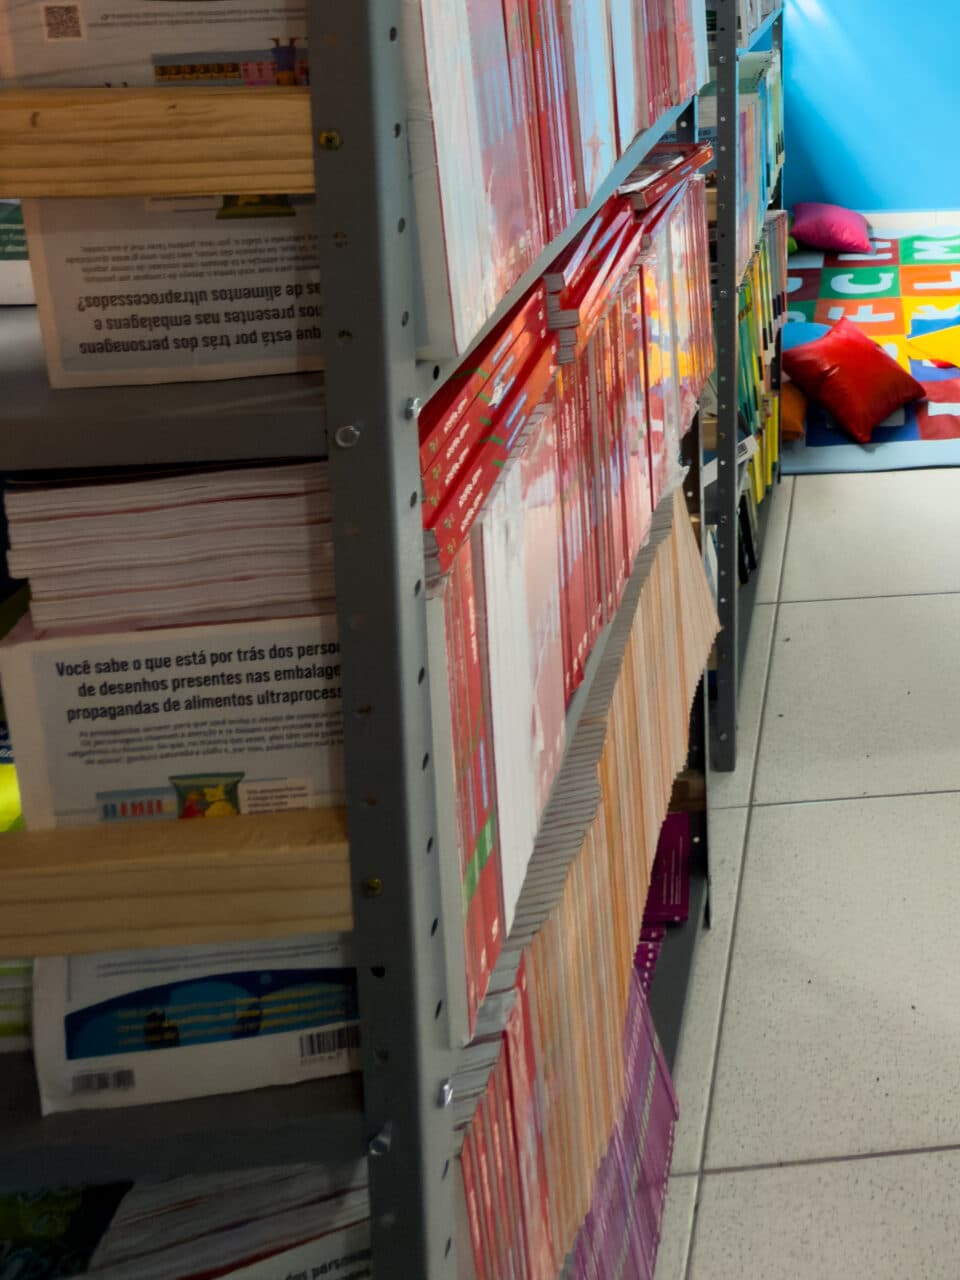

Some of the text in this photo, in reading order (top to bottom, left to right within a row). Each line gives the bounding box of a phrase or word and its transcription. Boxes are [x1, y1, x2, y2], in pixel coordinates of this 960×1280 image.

[211, 284, 282, 303] alimentos
[285, 282, 304, 299] de
[77, 289, 208, 313] ultraprocessados?
[105, 312, 192, 332] embalagens
[195, 312, 220, 327] nas
[223, 303, 295, 324] presentes
[94, 317, 103, 331] e
[79, 335, 170, 357] personagens
[173, 335, 198, 351] dos
[202, 333, 231, 351] trás
[236, 330, 257, 345] por
[262, 329, 292, 347] está
[56, 658, 91, 677] Você
[95, 657, 129, 674] sabe
[133, 658, 141, 671] o
[145, 656, 172, 674] que
[176, 650, 207, 667] está
[210, 651, 233, 670] por
[237, 646, 266, 662] trás
[269, 644, 294, 660] dos
[78, 680, 96, 698] de
[100, 678, 169, 696] desenhos
[171, 671, 243, 693] presentes
[246, 668, 270, 684] nas
[67, 699, 160, 723] propagandas
[163, 697, 182, 713] de
[184, 689, 254, 711] alimentos
